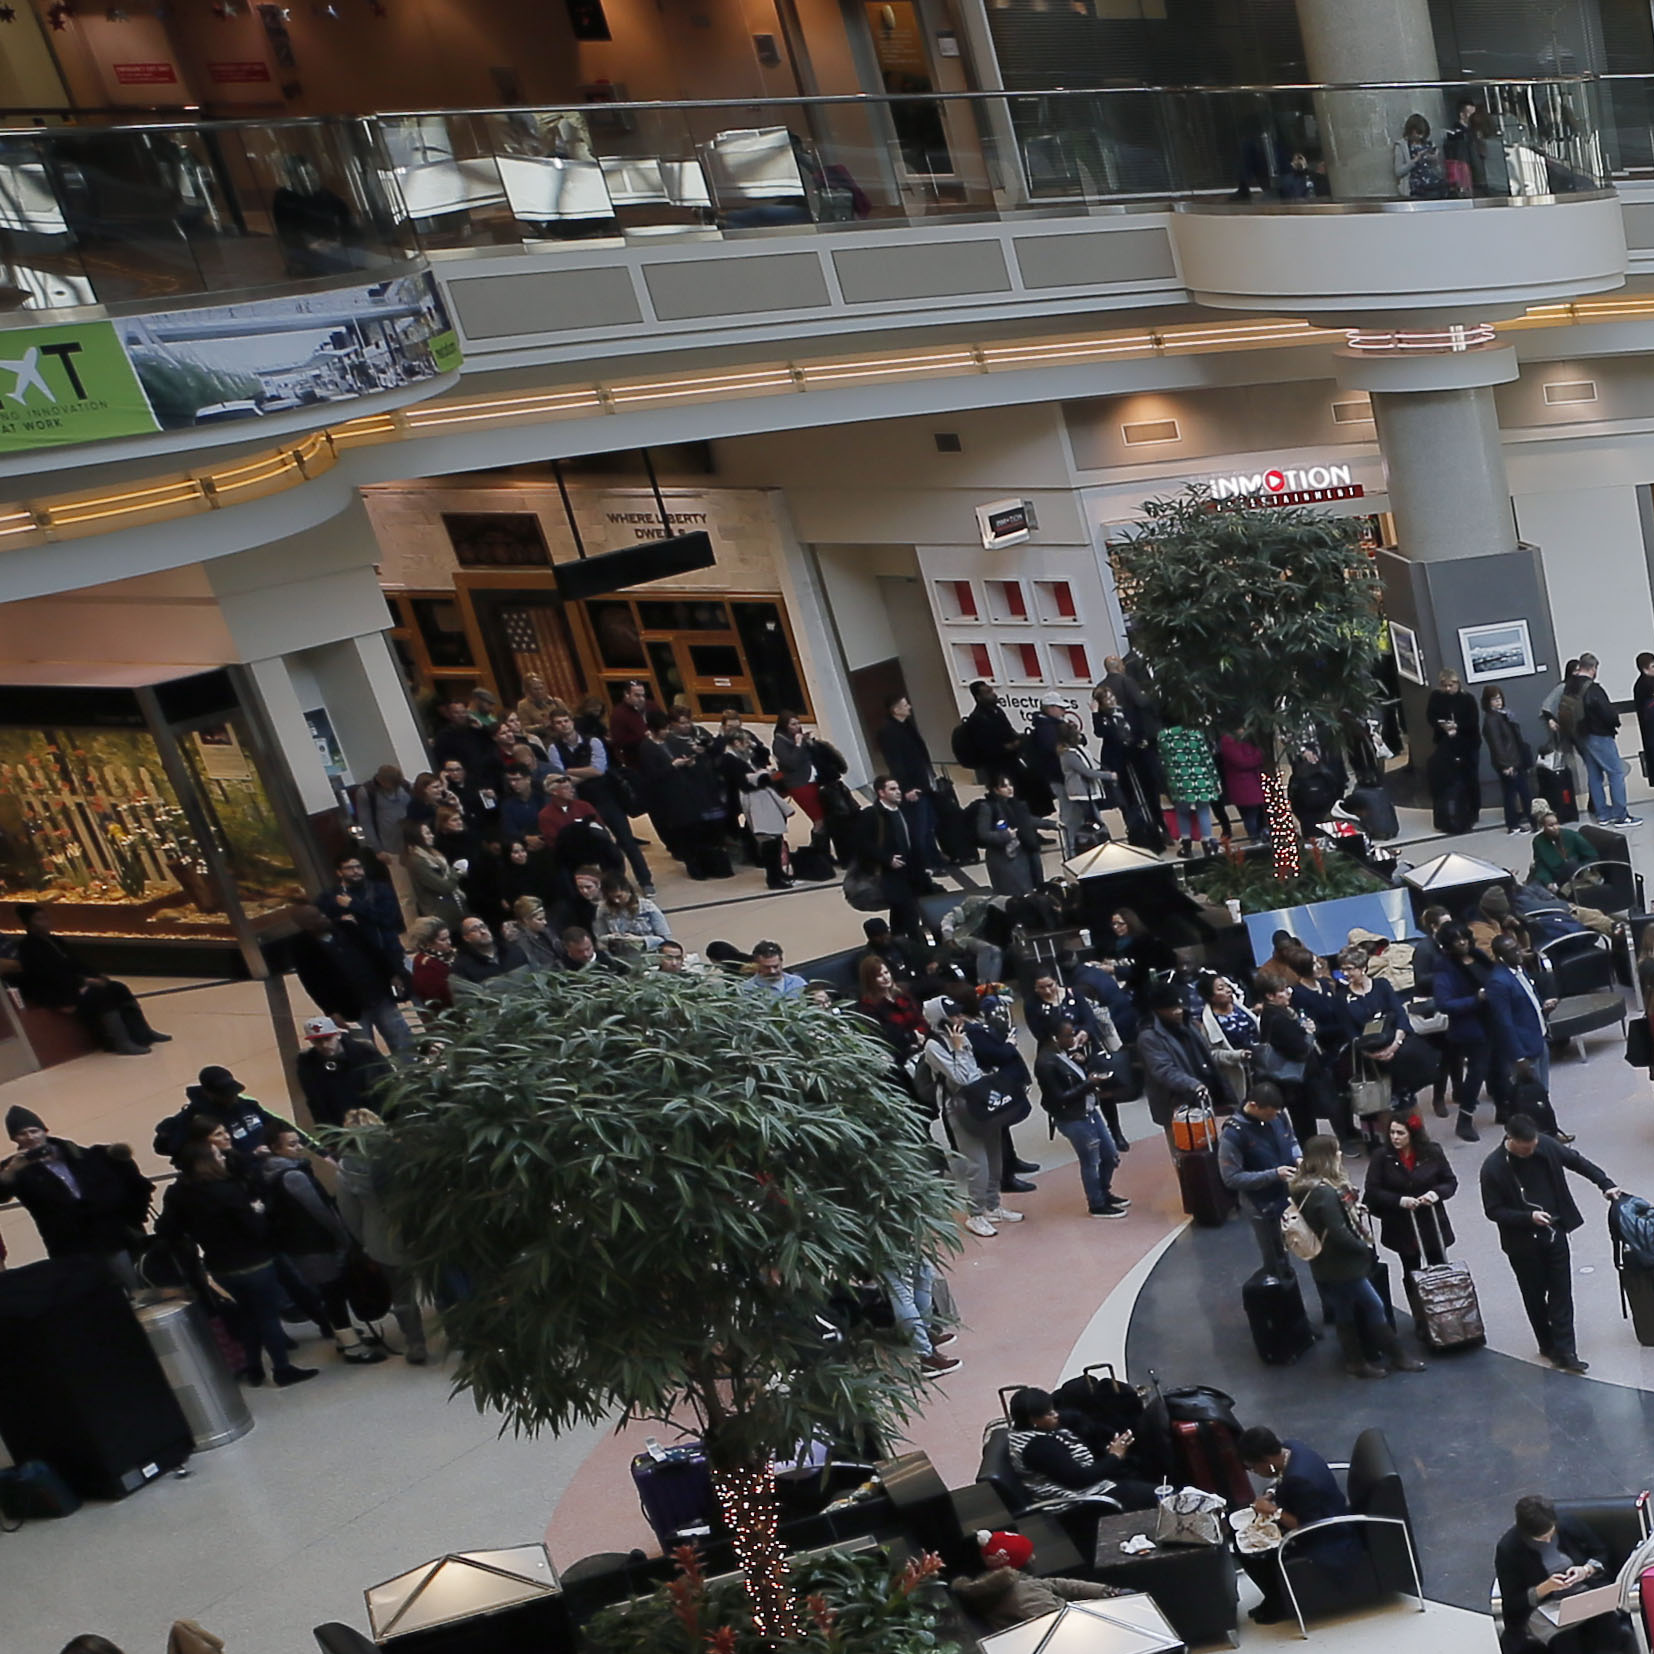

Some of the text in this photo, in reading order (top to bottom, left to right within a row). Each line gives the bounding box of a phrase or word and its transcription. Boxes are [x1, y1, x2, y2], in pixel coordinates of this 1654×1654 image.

[28, 400, 108, 417] INNOVATION
[2, 419, 63, 433] AT WORK
[606, 513, 707, 524] WHERE LBERTY
